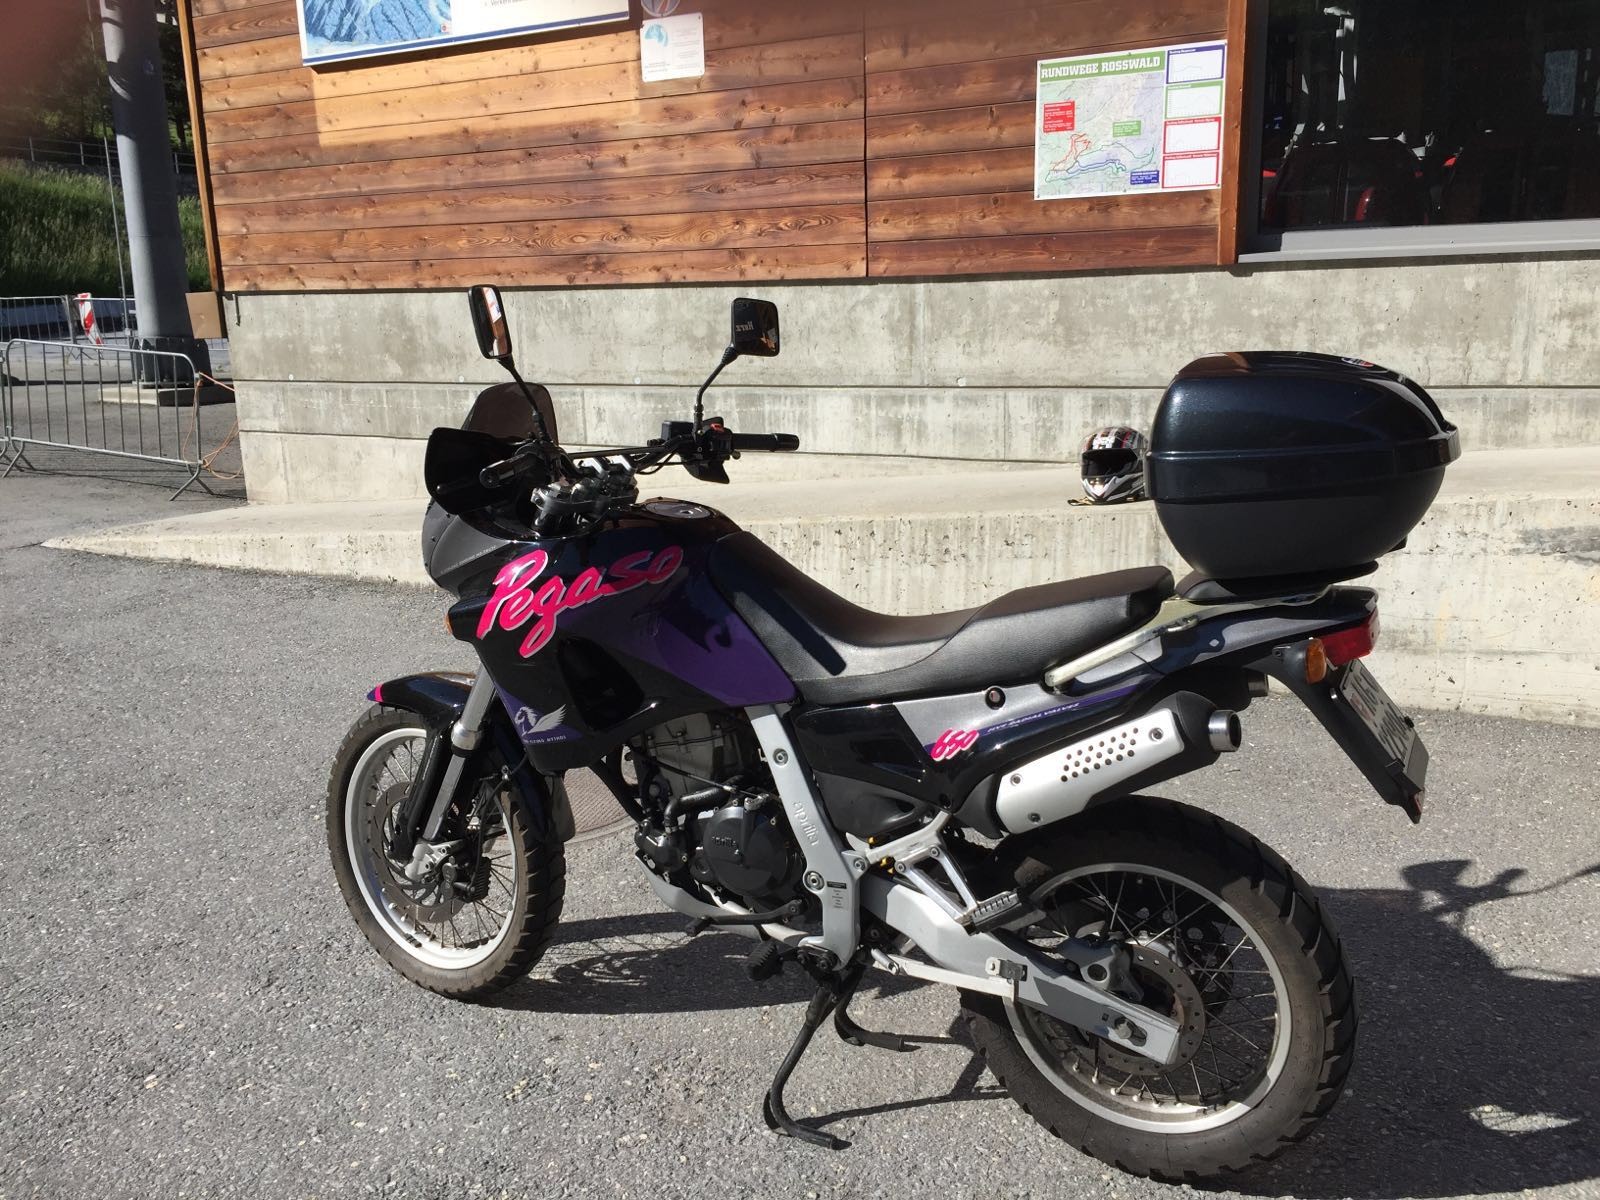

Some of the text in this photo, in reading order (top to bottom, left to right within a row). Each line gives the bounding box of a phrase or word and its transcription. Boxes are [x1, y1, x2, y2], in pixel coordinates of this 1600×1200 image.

[1041, 57, 1160, 78] RUNDWEGE ROSSWALD
[476, 546, 684, 658] Pegaso
[931, 729, 979, 761] 650
